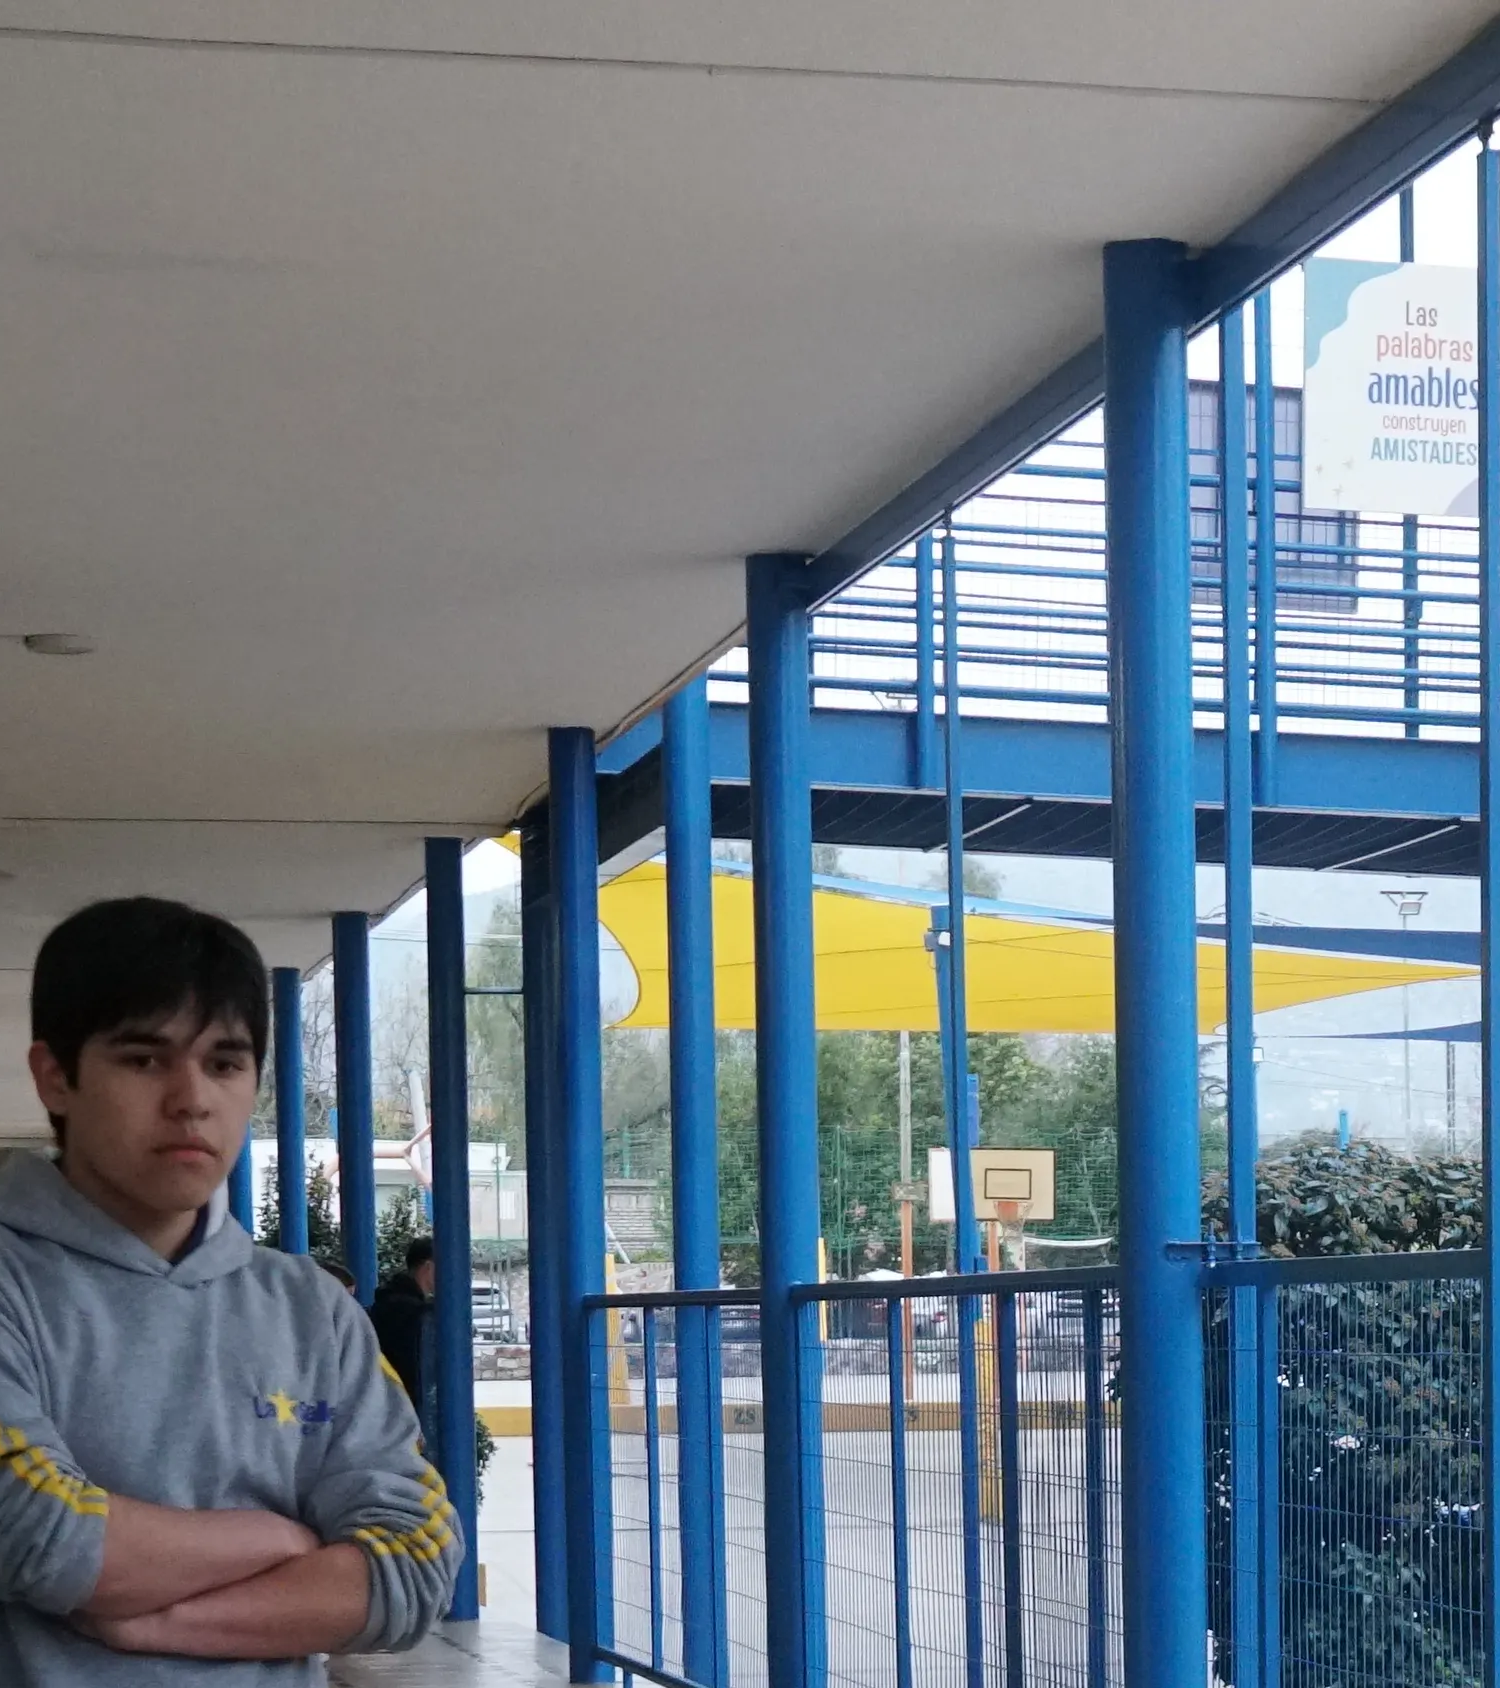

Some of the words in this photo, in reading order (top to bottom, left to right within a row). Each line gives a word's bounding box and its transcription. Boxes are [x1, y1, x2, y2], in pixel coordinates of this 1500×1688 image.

[1405, 300, 1438, 327] Las
[1376, 331, 1474, 362] palabras
[1368, 366, 1480, 410] amables
[1382, 413, 1467, 436] construyen
[1370, 436, 1478, 466] AMISTADES
